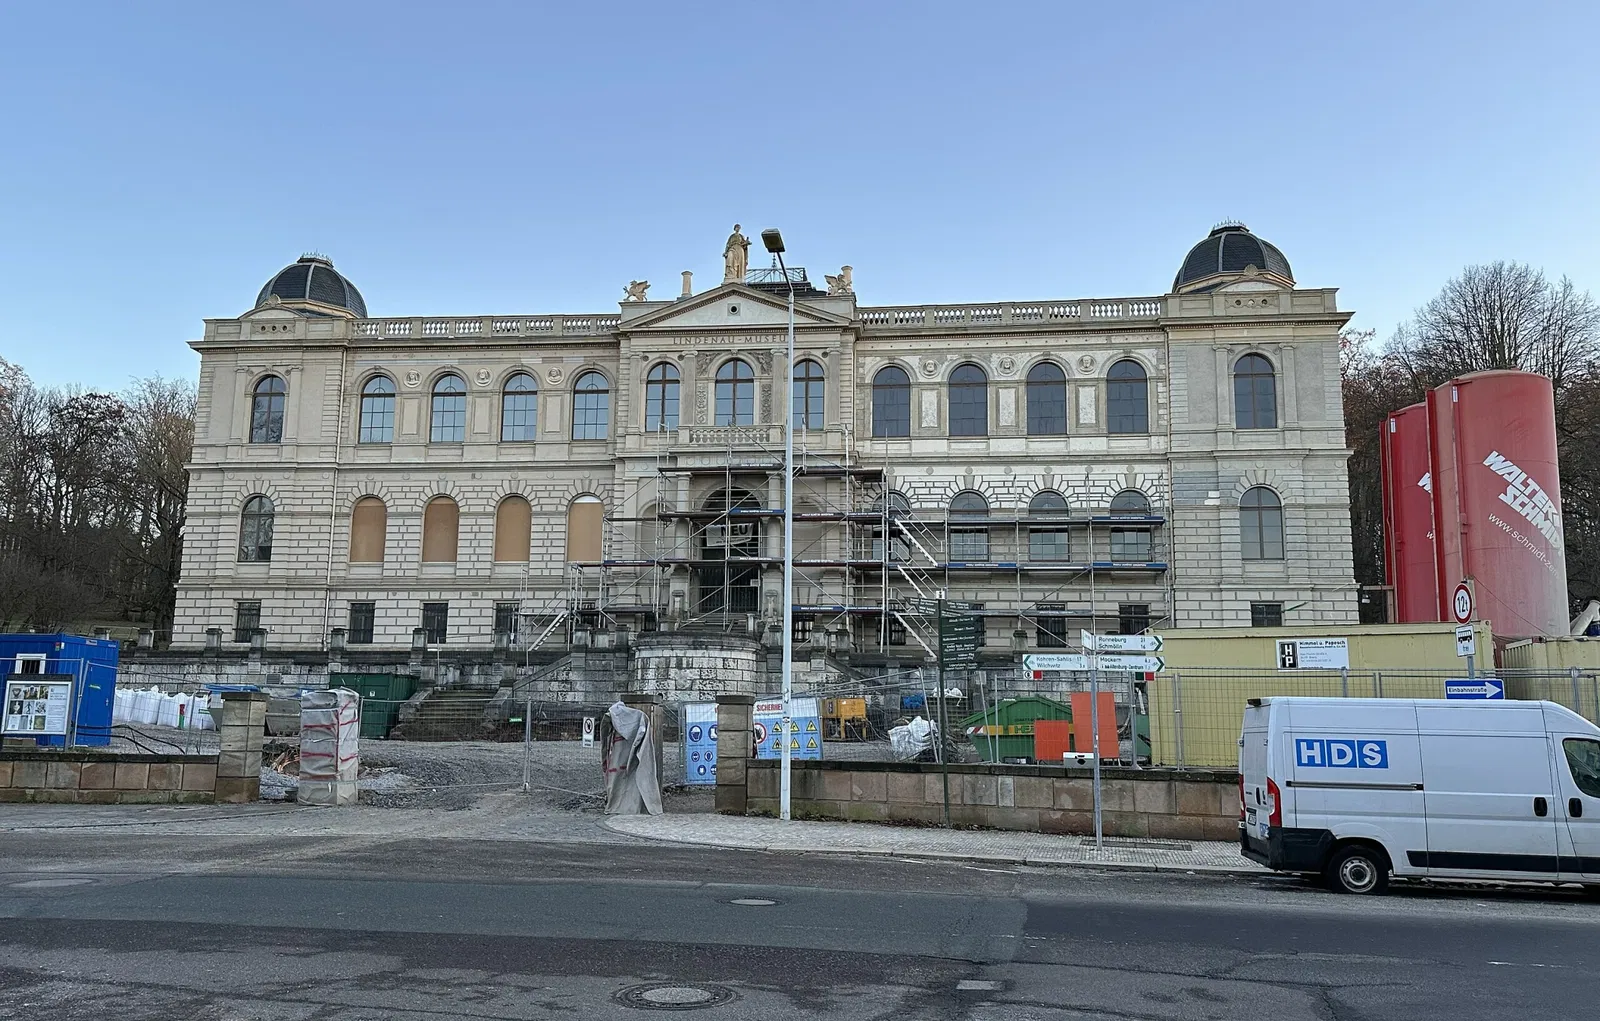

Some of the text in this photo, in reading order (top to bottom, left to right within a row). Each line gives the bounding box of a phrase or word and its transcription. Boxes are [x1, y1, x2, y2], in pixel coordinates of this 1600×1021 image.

[720, 524, 748, 537] NEU
[1448, 685, 1488, 693] Einbahnstraße
[756, 703, 783, 712] SICHERHEI
[1300, 741, 1382, 766] HDS
